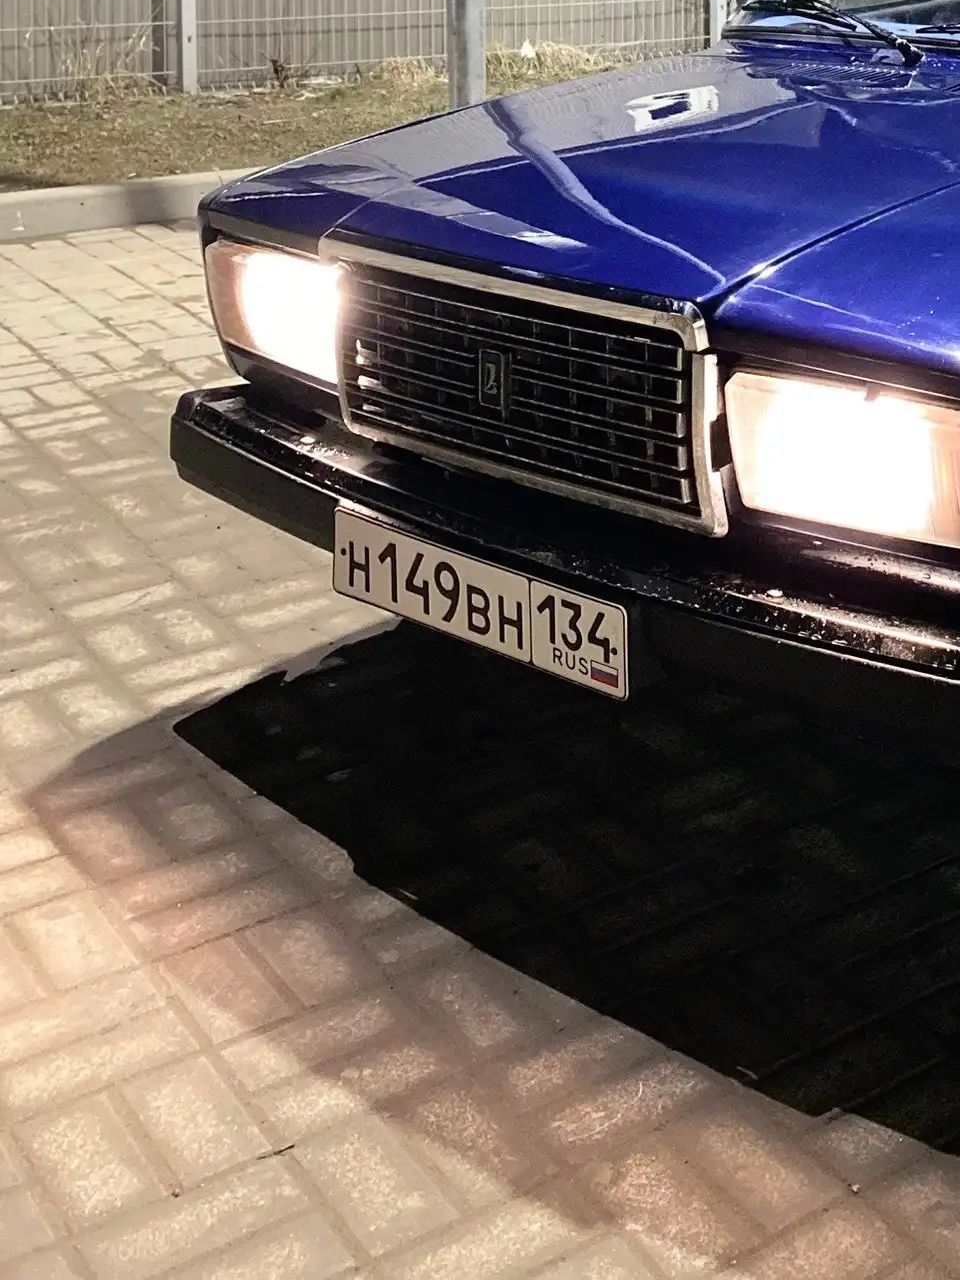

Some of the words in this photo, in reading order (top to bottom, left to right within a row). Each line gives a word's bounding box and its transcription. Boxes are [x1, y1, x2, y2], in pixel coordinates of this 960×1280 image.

[349, 540, 524, 650] Н149ВН
[536, 594, 611, 664] 134
[552, 646, 589, 676] RUS
